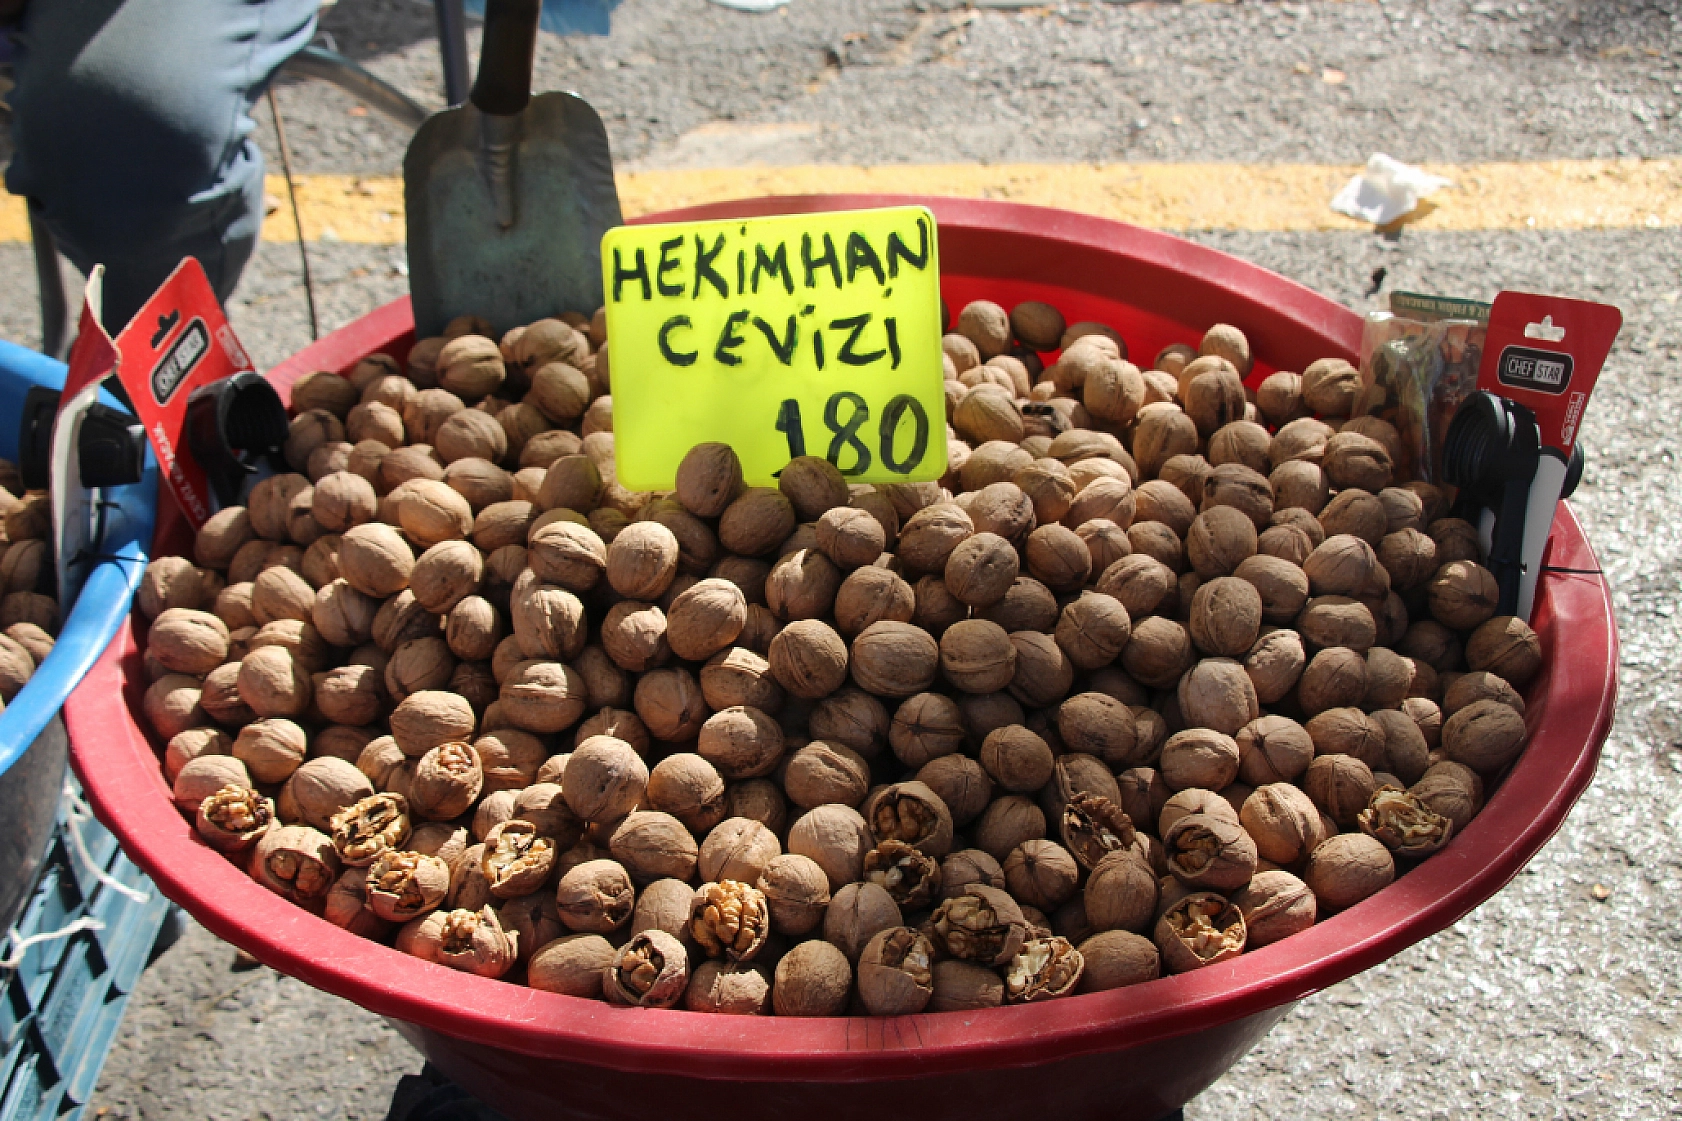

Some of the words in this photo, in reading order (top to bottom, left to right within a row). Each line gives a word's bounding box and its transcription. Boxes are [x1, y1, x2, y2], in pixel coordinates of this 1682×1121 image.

[612, 216, 930, 302] HEKİMHAN
[658, 286, 902, 371] CEVİZİ
[1507, 358, 1535, 377] CHEF
[1536, 363, 1563, 382] STAR
[772, 391, 930, 478] 180
